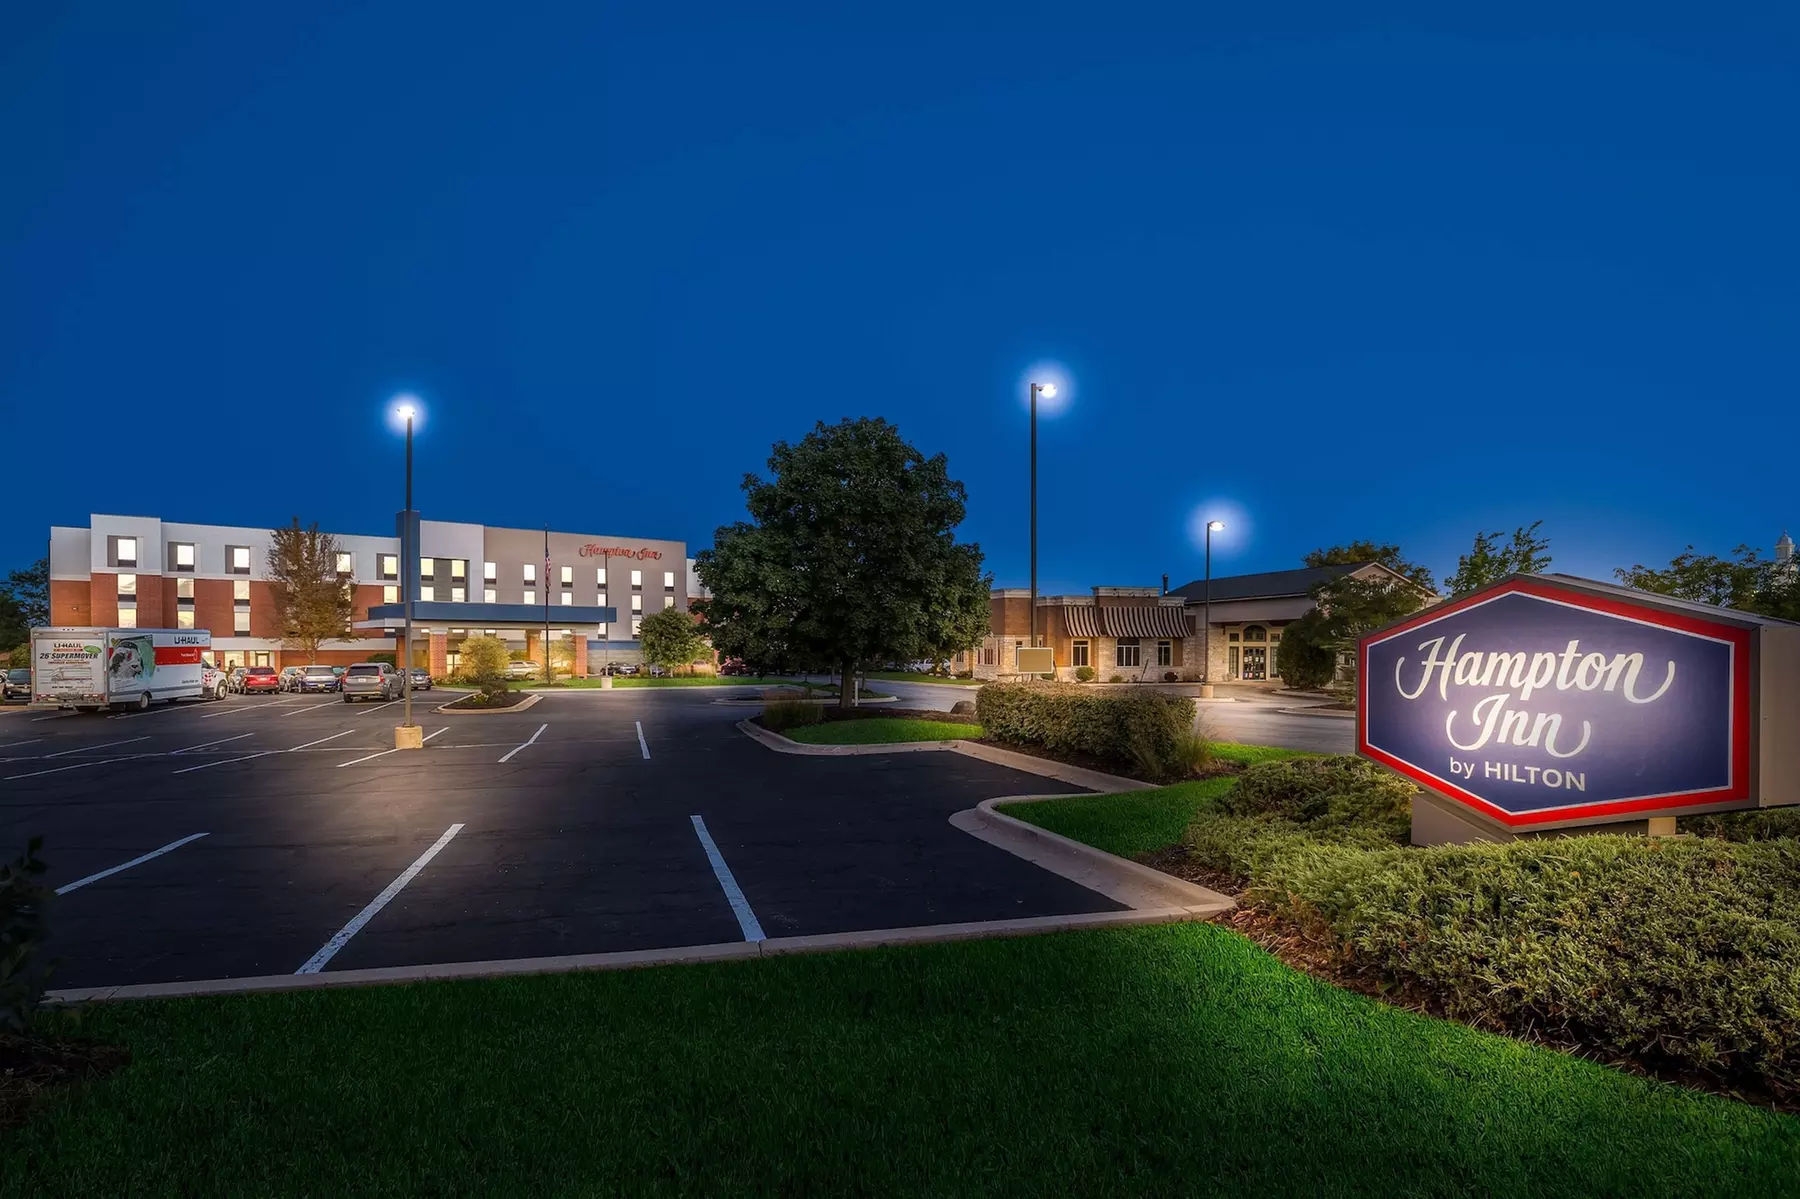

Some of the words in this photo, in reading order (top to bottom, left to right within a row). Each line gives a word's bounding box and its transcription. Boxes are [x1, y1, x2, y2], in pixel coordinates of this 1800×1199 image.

[636, 547, 662, 561] Inn
[174, 636, 200, 645] U-HAUL
[1396, 633, 1675, 704] Hampton
[1446, 693, 1591, 758] Inn
[1450, 756, 1475, 779] by
[1484, 761, 1586, 792] HILTON
